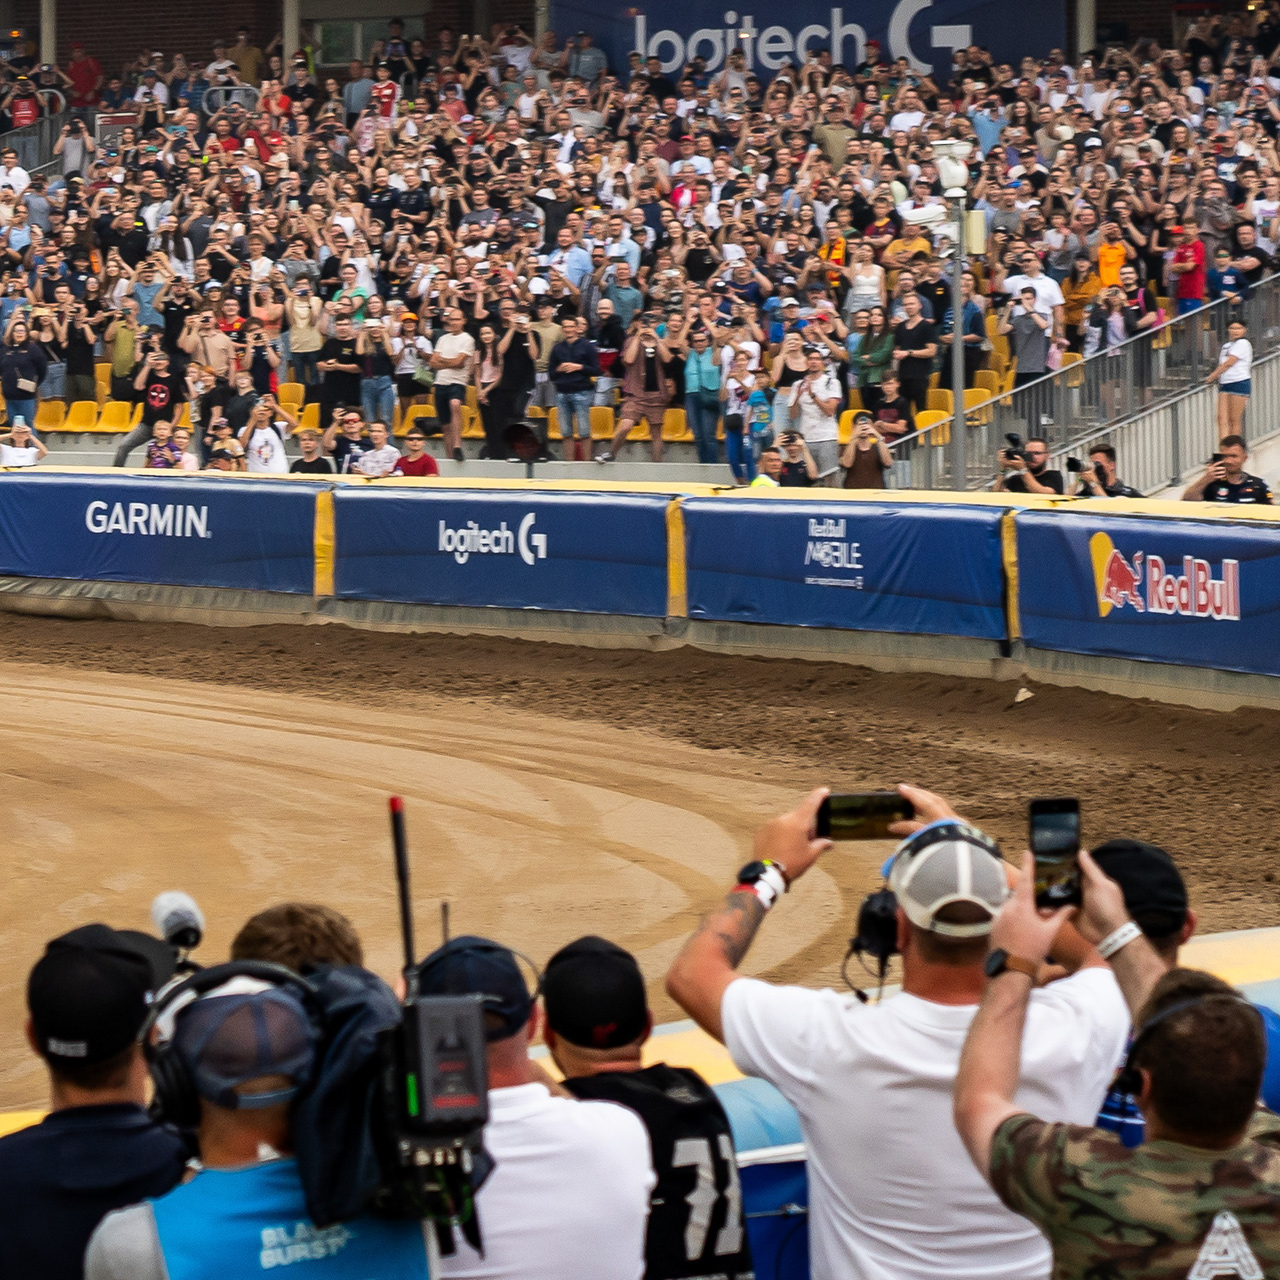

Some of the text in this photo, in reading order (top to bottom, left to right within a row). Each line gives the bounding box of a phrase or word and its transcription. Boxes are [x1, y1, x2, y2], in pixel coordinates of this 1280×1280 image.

[635, 8, 865, 75] logitech
[86, 500, 208, 538] GARMIN
[439, 521, 515, 565] logitech
[1146, 555, 1240, 620] Red Bull
